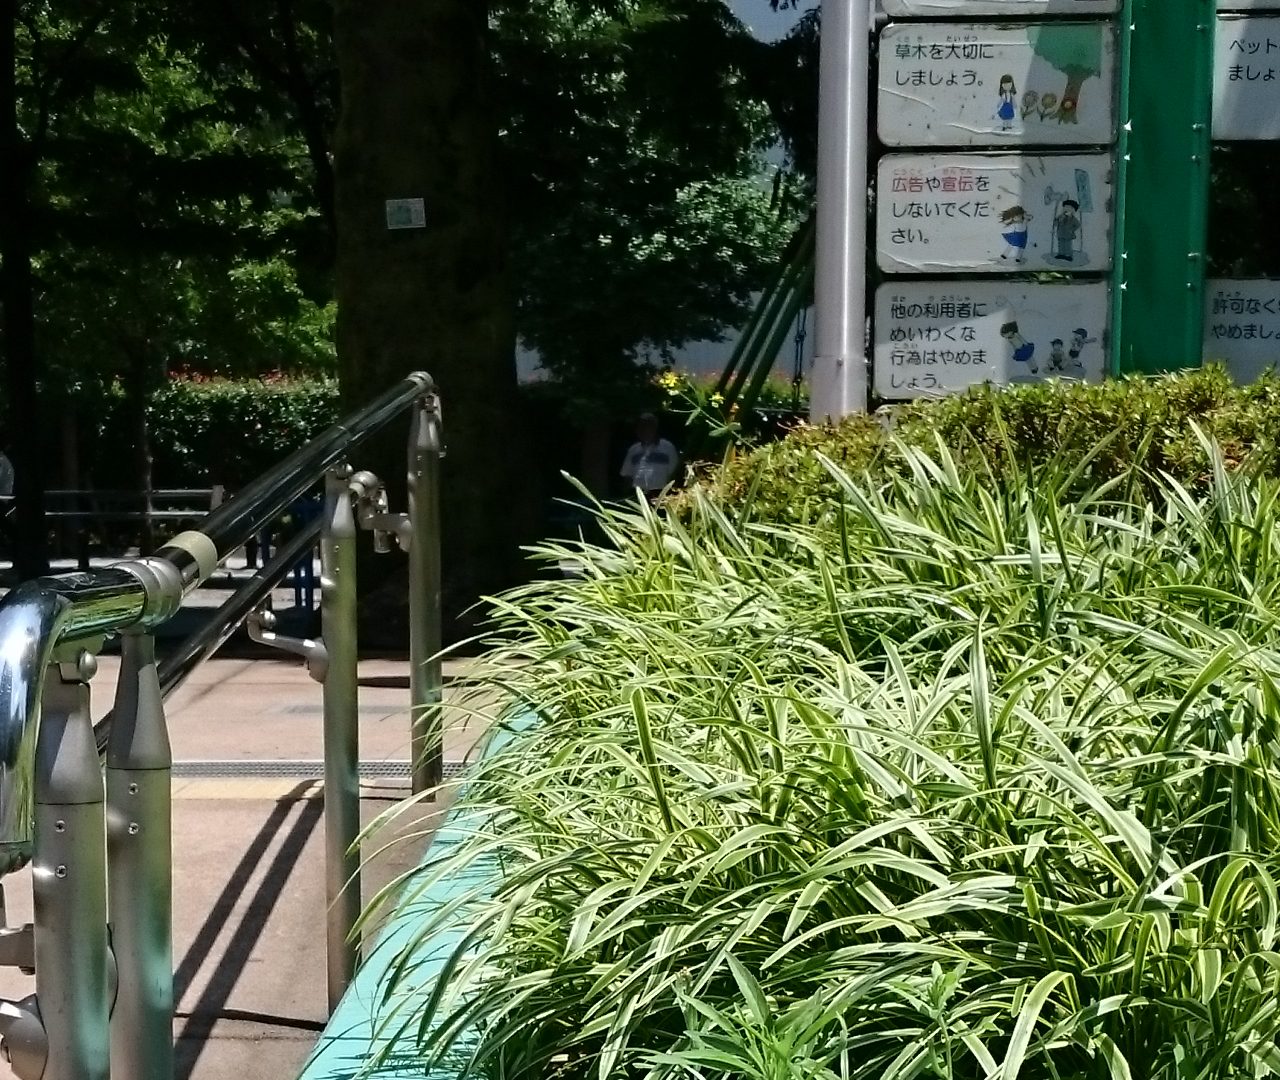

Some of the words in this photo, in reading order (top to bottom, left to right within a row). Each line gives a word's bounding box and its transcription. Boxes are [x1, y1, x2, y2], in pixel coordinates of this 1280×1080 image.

[895, 43, 994, 59] 草木を大切に
[895, 69, 984, 87] しましょう。
[892, 176, 990, 193] 広告や宣伝を
[893, 201, 990, 218] しないでくだ
[891, 228, 930, 244] さい。
[890, 303, 987, 319] 他の利用者に
[890, 326, 976, 341] めいわくな
[890, 349, 987, 365] 行為はやめま
[890, 373, 943, 389] しょう。
